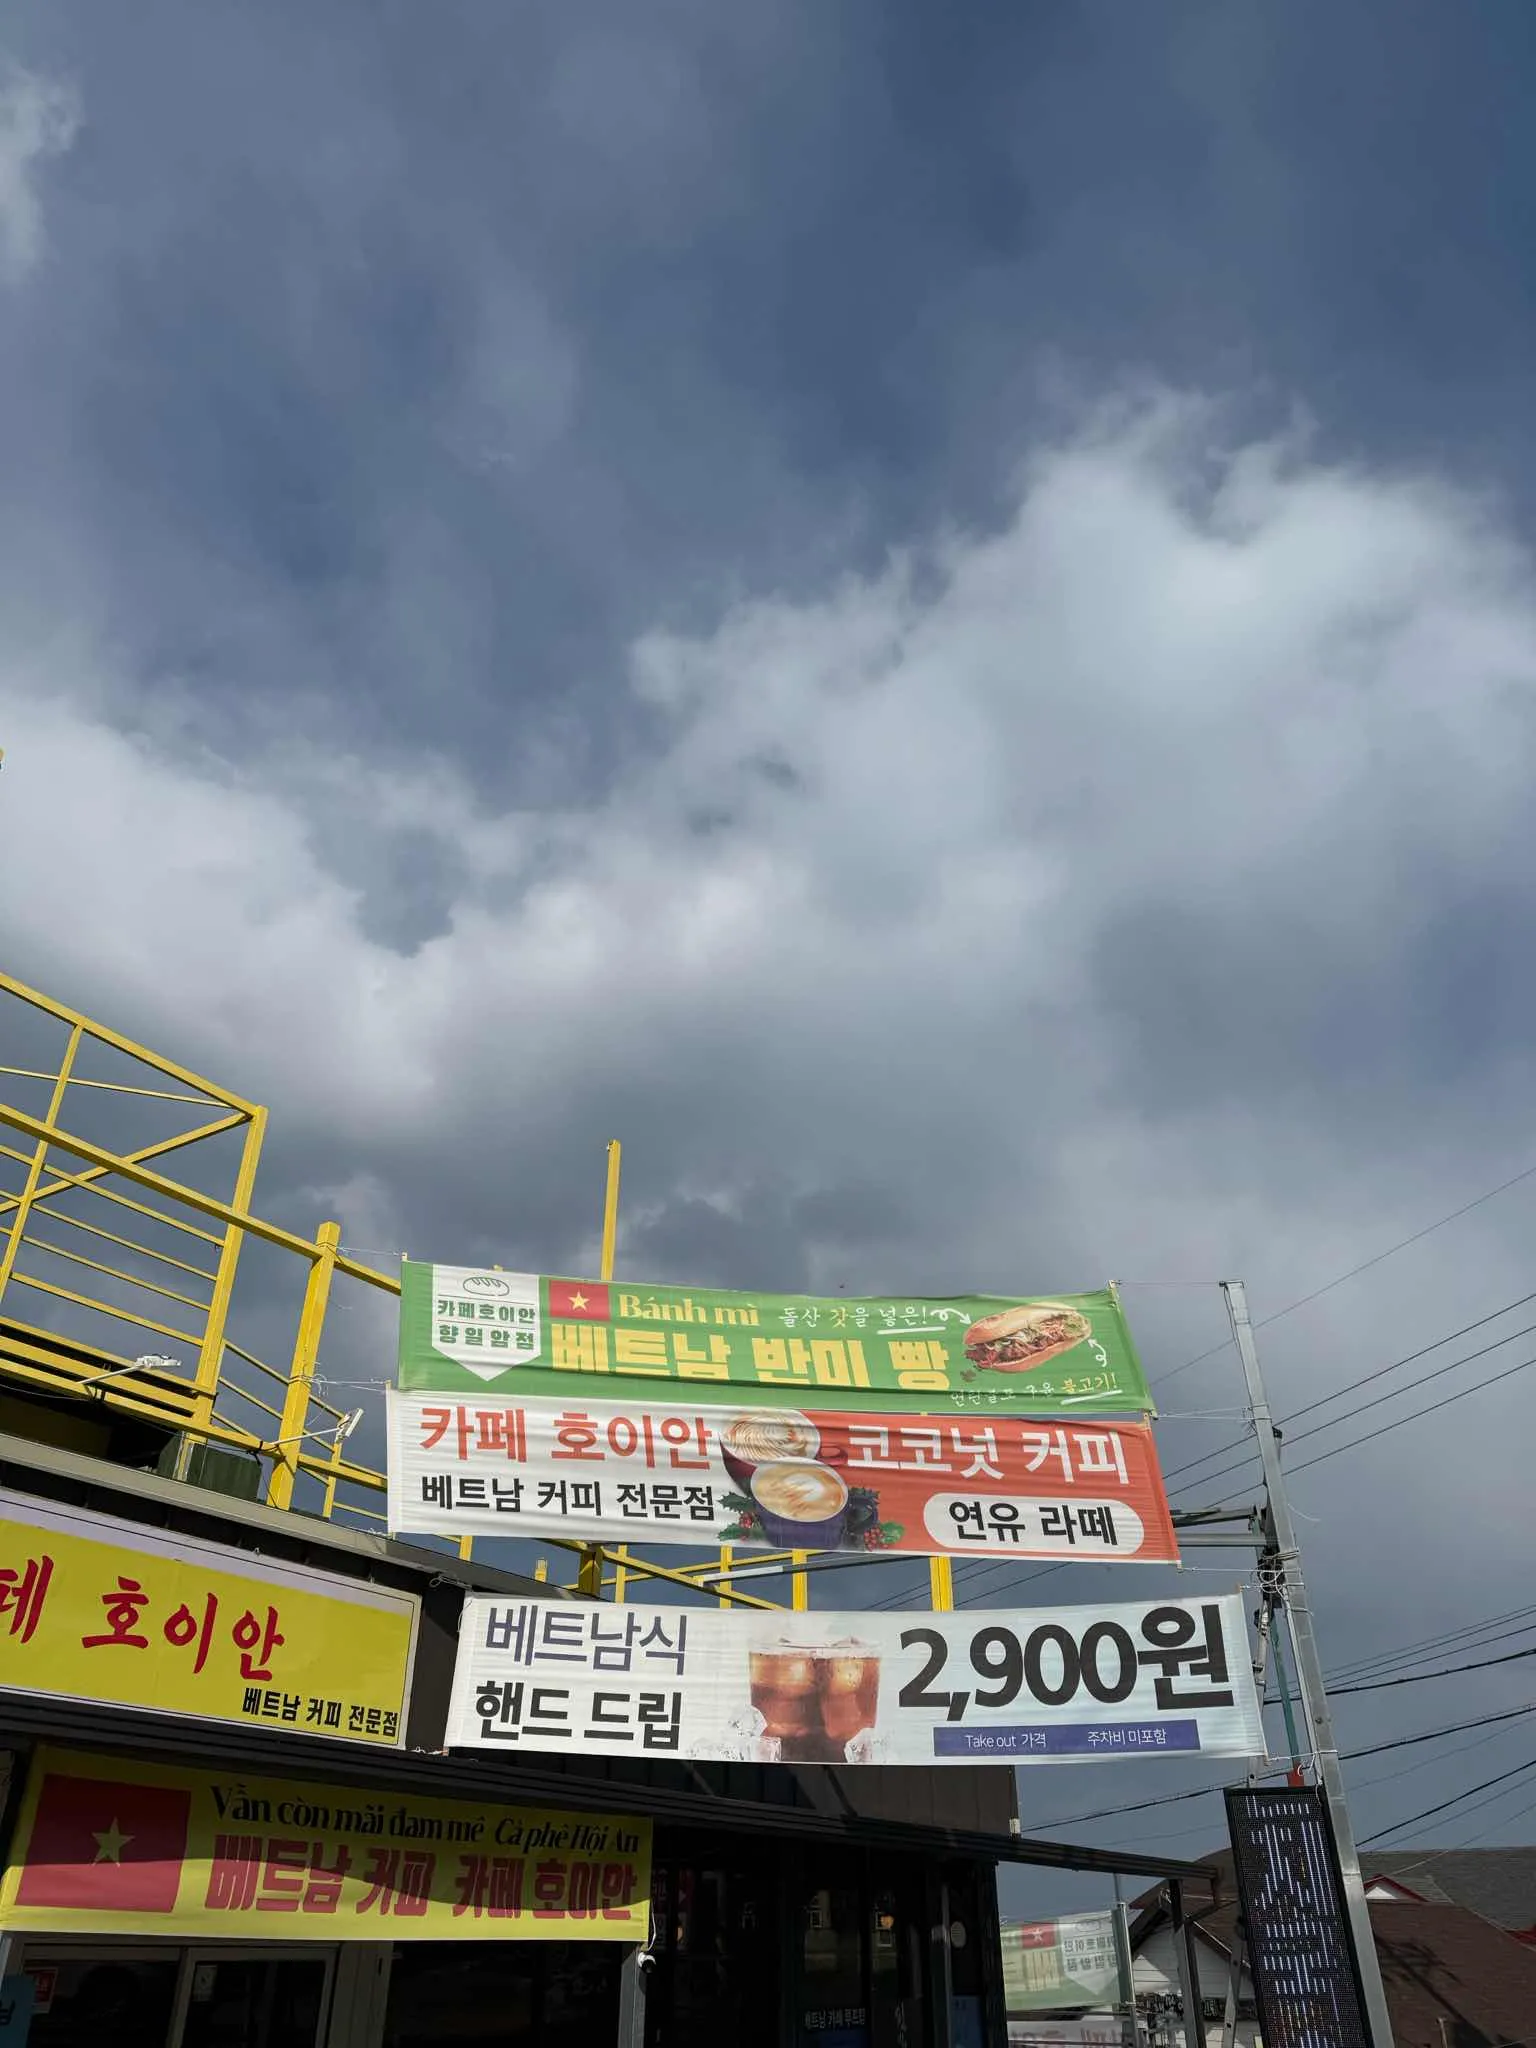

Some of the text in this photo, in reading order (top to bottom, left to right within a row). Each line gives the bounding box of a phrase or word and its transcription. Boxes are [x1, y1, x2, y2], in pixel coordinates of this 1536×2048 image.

[437, 1300, 535, 1324] 카페호이안
[619, 1294, 760, 1327] Bánh mì
[779, 1305, 927, 1328] 돌산 갓을 넣은!
[439, 1325, 534, 1350] 향일암점
[552, 1324, 950, 1390] 베트남 반미 빵
[1061, 1372, 1117, 1394] 불고기!
[420, 1406, 713, 1470] 카페 호이안
[848, 1424, 1129, 1485] 코코넛 커피
[421, 1474, 715, 1521] 베트남 커피 전문점
[949, 1500, 1118, 1546] 연유 라떼
[81, 1575, 285, 1682] 호이안
[486, 1604, 688, 1676] 베트남식
[899, 1603, 1234, 1721] 2,900원
[242, 1687, 398, 1737] 베트남 커피 전문점
[475, 1680, 682, 1751] 핸드 드립
[965, 1732, 1047, 1748] Take out 가격
[1087, 1728, 1167, 1749] 주차비 미포함
[210, 1784, 272, 1822] Vẫn
[277, 1797, 330, 1830] còn
[334, 1804, 384, 1835] mãi
[447, 1816, 486, 1842] mê
[495, 1816, 524, 1846] Cà
[521, 1821, 570, 1853] phê
[570, 1823, 609, 1856] Hội
[204, 1834, 353, 1914] 베트남
[356, 1847, 437, 1917] 커피
[452, 1853, 525, 1919] 카페
[532, 1856, 638, 1921] 호이안
